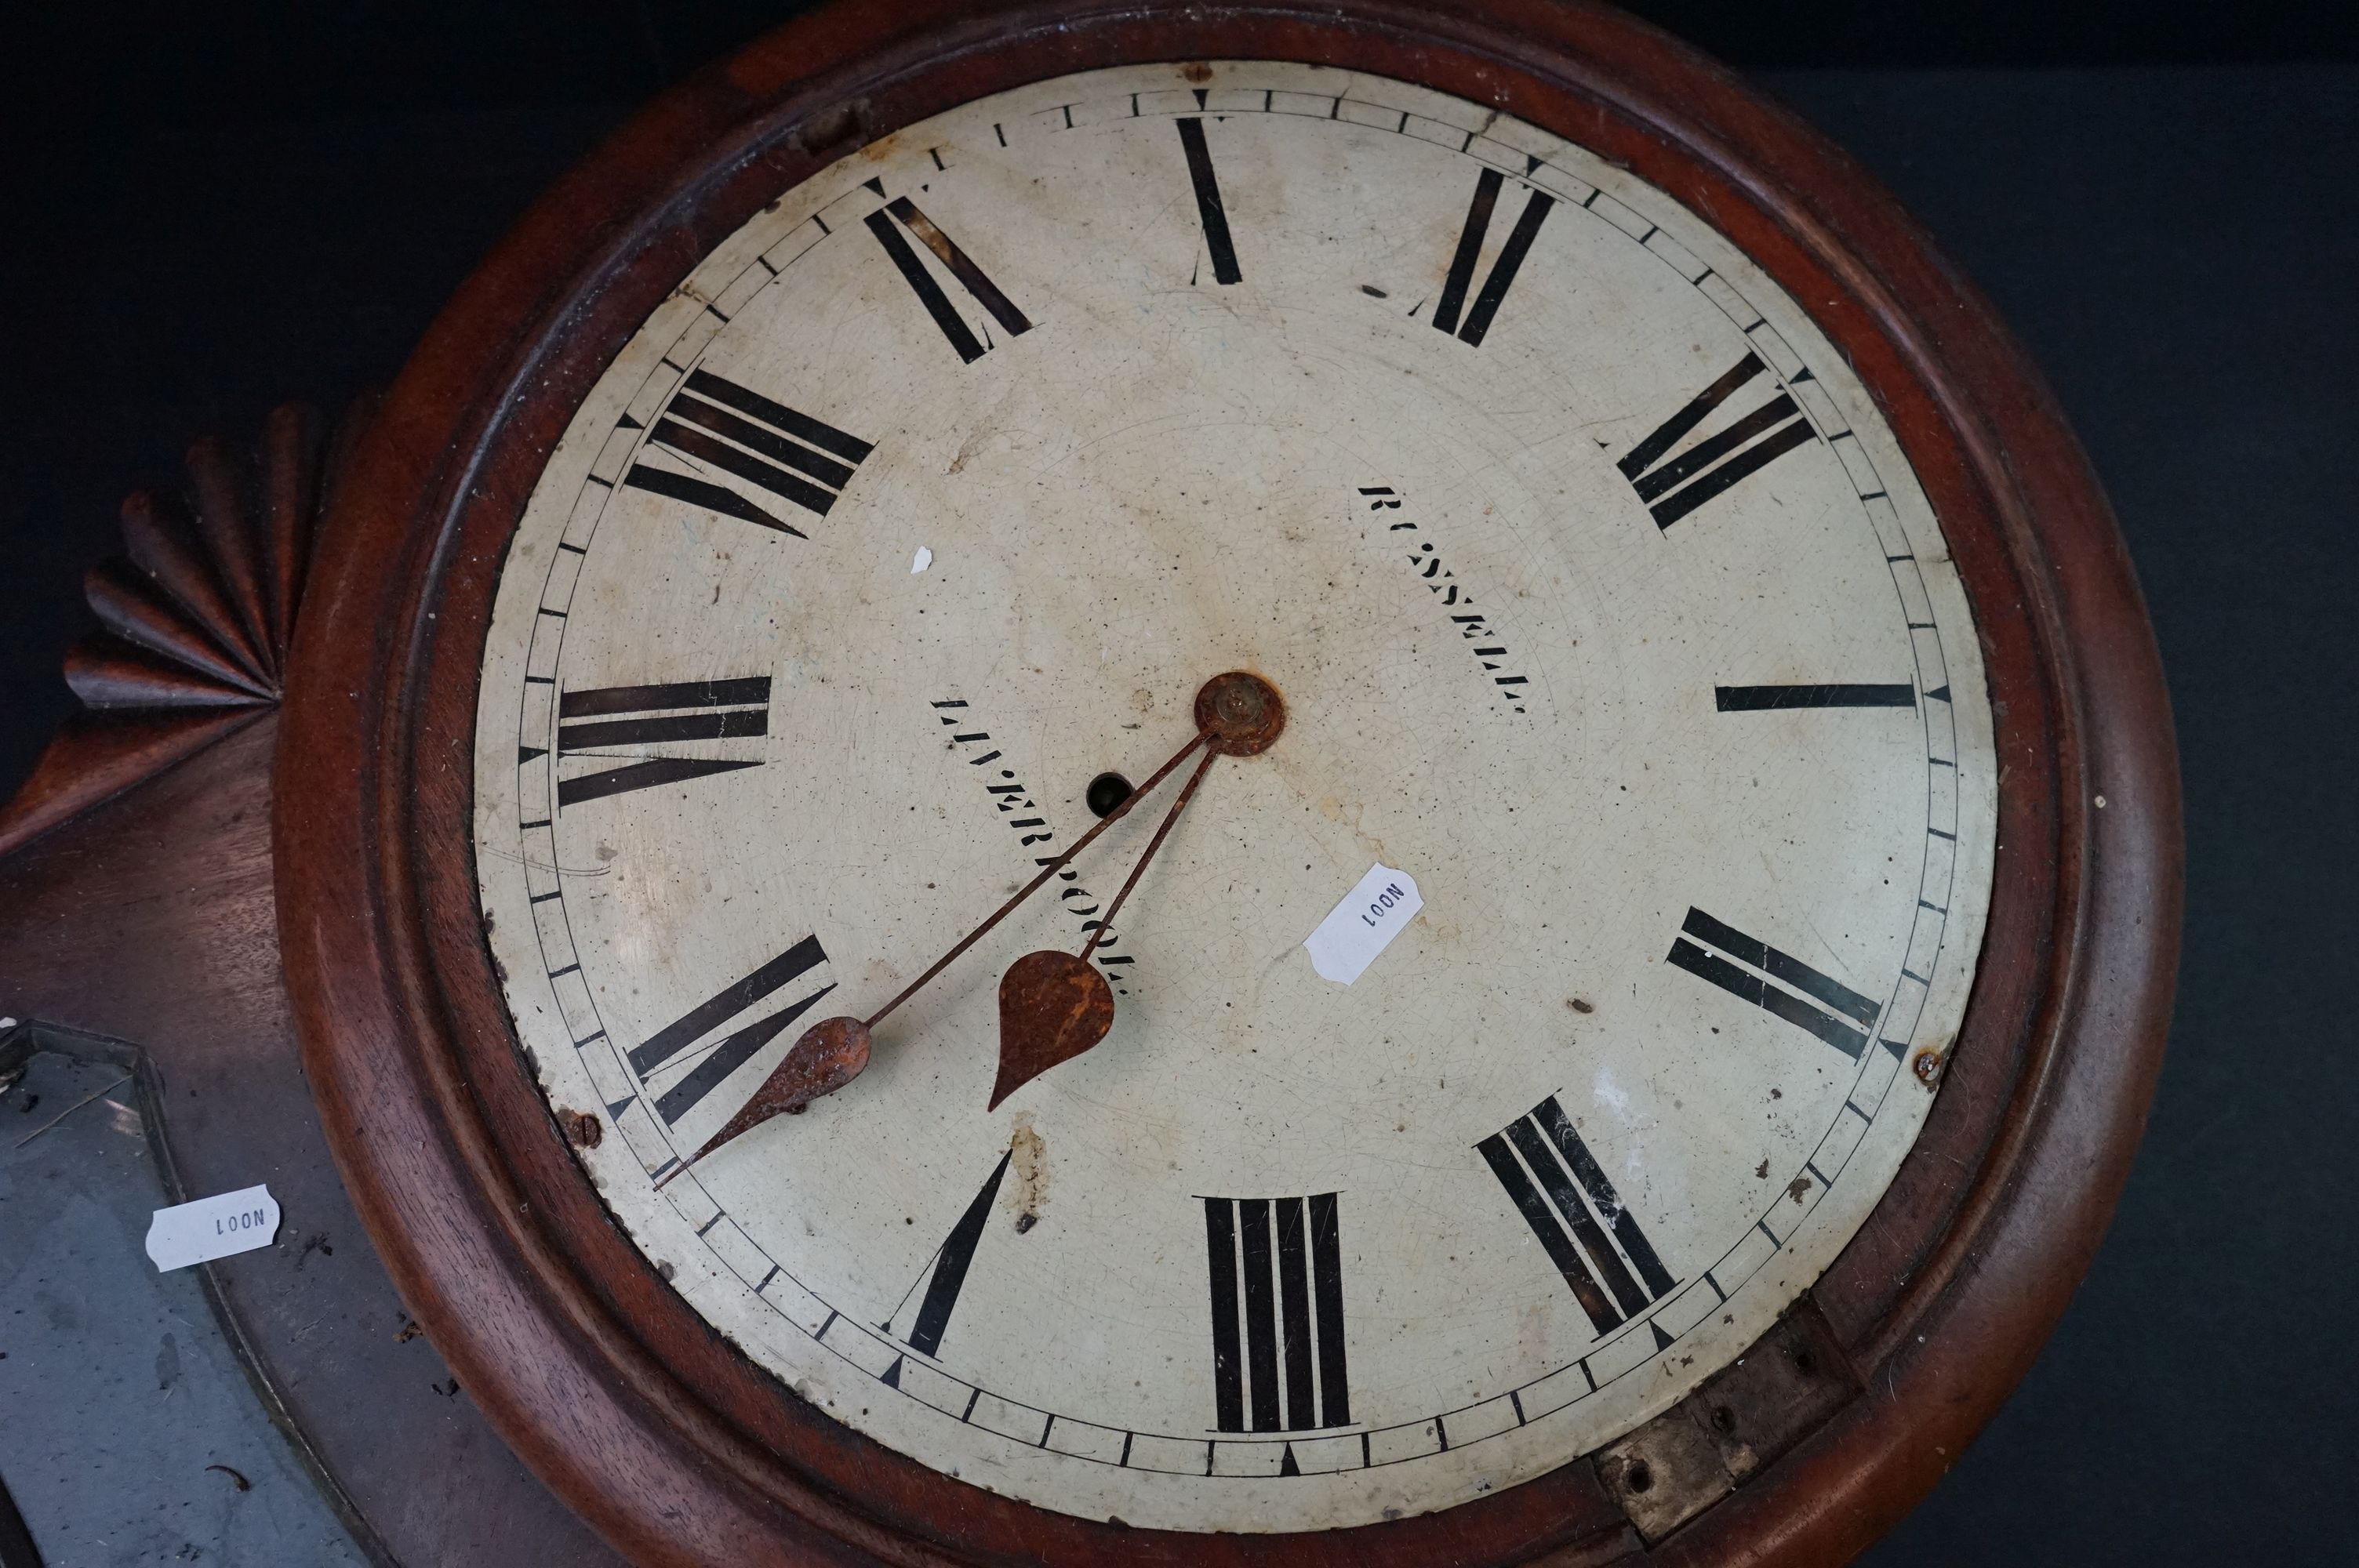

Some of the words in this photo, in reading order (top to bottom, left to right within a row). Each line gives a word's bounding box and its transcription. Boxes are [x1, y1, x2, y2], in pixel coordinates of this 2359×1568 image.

[619, 357, 880, 543] VIII
[557, 666, 774, 818] VII
[623, 934, 838, 1134] VI
[1664, 906, 1884, 1066] II
[871, 1147, 1013, 1363] V
[1191, 1191, 1361, 1432] IIII
[1471, 1090, 1685, 1342] III
